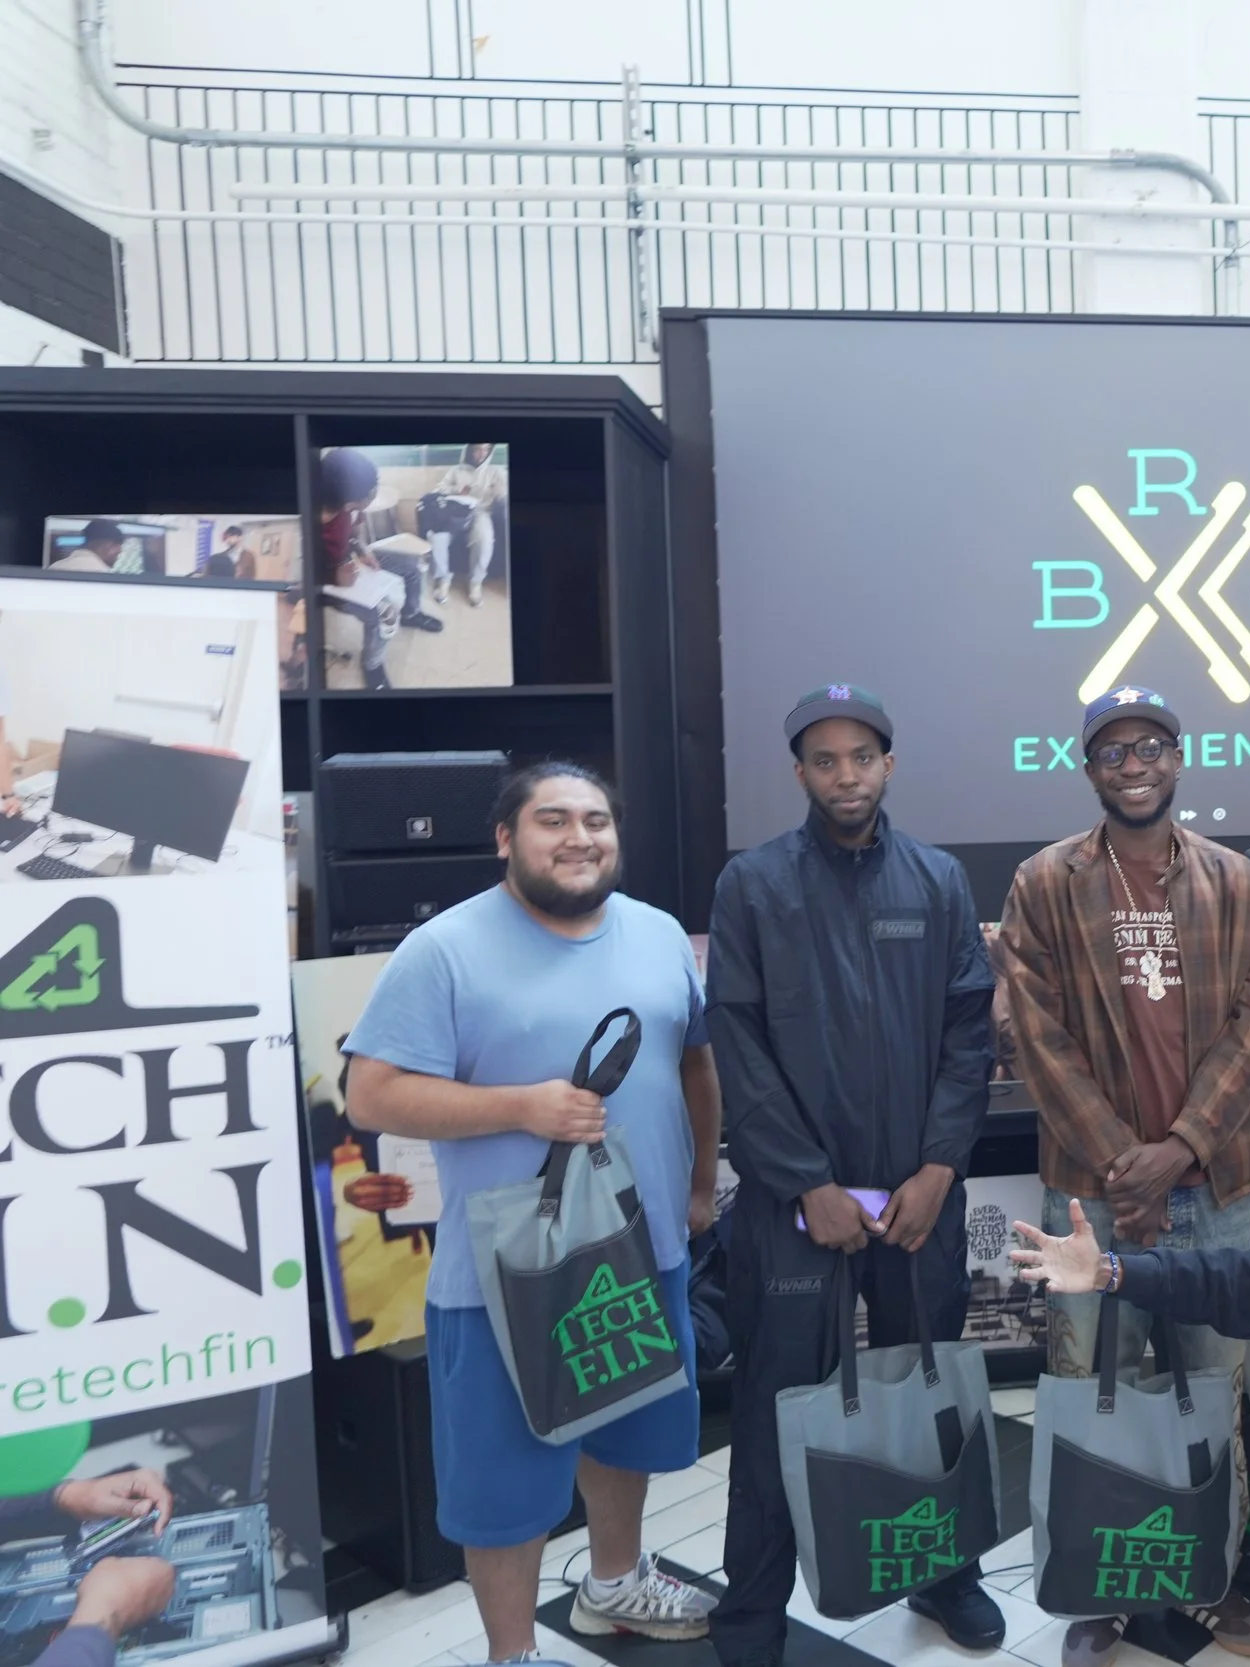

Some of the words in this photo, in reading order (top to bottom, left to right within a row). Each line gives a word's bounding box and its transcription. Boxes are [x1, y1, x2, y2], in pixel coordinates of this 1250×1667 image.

[551, 1286, 661, 1356] TECH
[0, 1332, 276, 1413] etechfin
[859, 1514, 956, 1555] TECH
[1092, 1526, 1195, 1567] TECH
